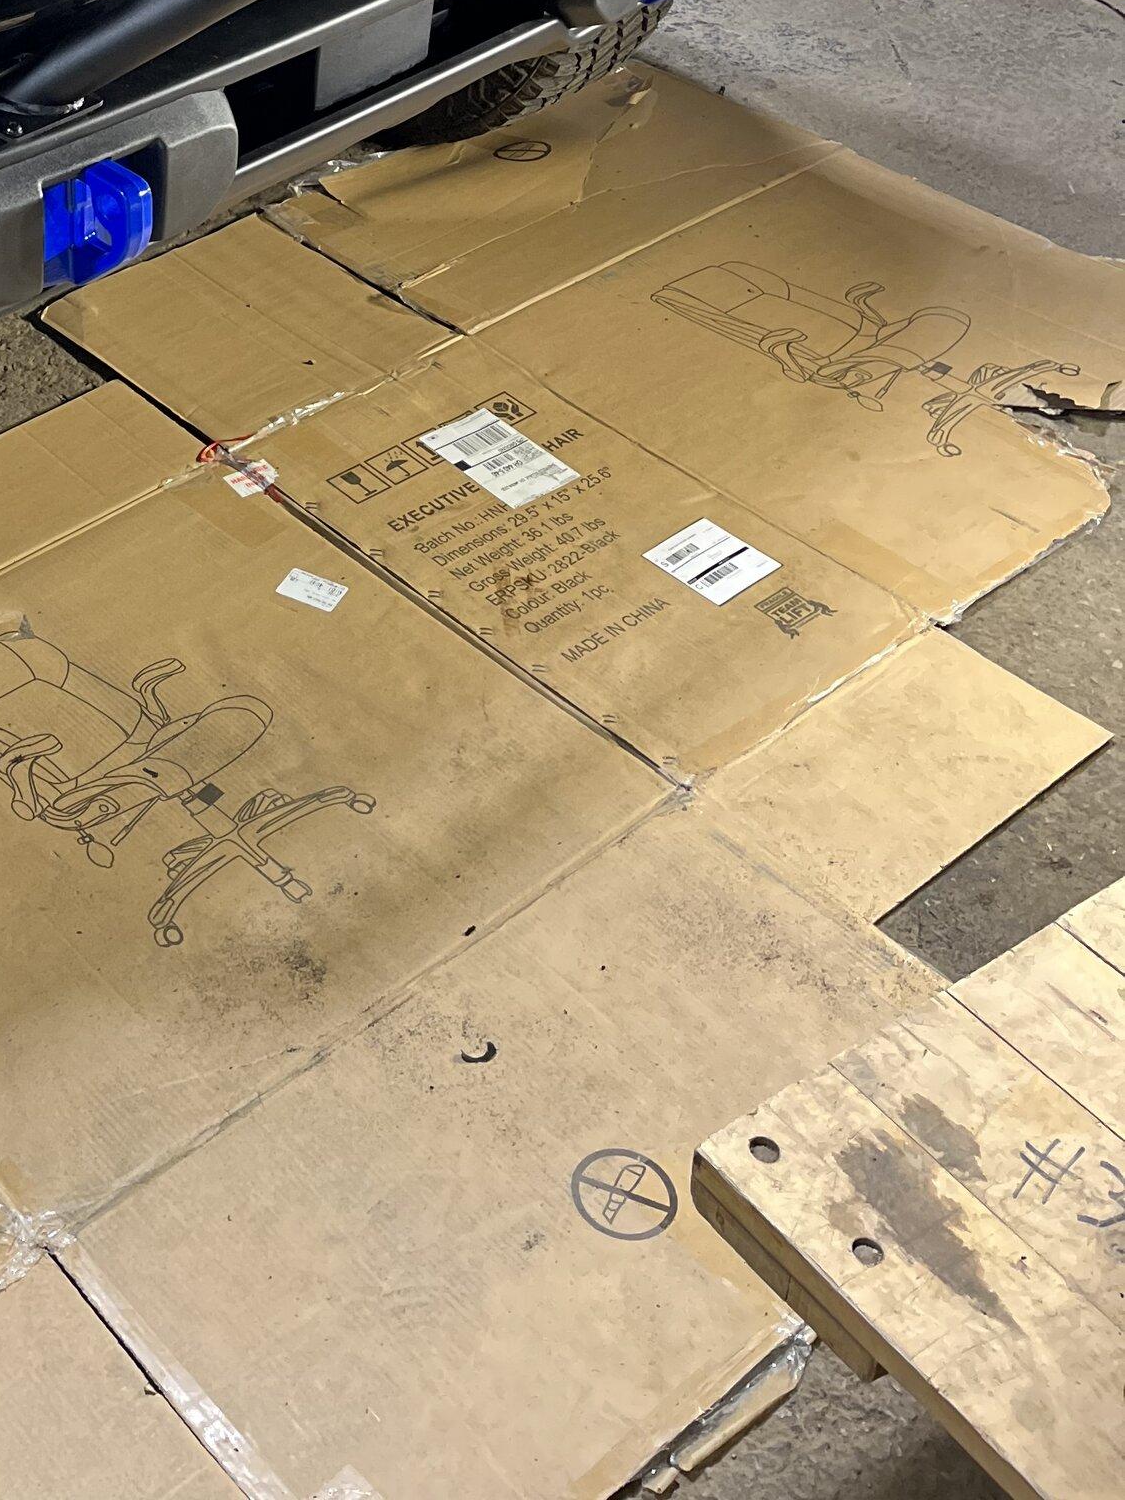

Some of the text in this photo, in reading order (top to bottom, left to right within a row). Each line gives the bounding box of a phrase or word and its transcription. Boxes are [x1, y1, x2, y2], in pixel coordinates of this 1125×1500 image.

[387, 481, 480, 532] EXECUTIVE
[541, 428, 584, 452] HAIR
[415, 531, 457, 554] Batch
[431, 523, 512, 567] Dimensions:
[542, 501, 554, 510] x
[551, 488, 571, 504] 15"
[571, 485, 586, 494] x
[449, 512, 574, 580] Net Weight: 36.1 lbs
[468, 518, 606, 593] Gross Weight: 40.7 lbs
[485, 568, 552, 607] ERPSKU:
[547, 529, 621, 575] 2822-Black
[505, 571, 593, 620] Colour: Black
[524, 600, 585, 634] Quantity:
[561, 597, 671, 663] MADE IN CHINA
[770, 598, 802, 616] TEAM
[779, 603, 811, 624] LIFT
